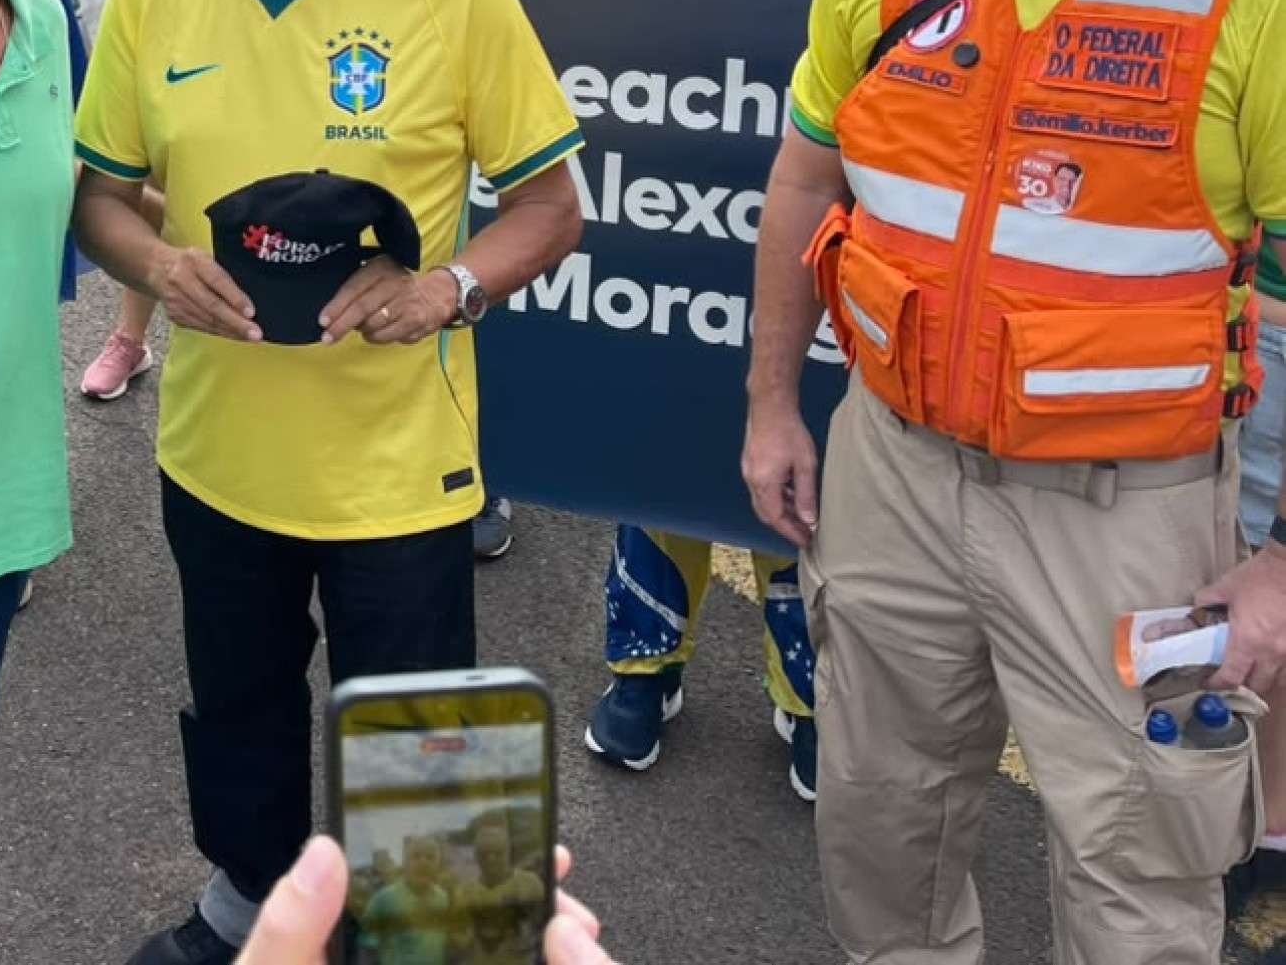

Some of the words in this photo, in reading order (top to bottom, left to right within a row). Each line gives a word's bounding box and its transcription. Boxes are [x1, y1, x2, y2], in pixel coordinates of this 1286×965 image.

[1056, 23, 1071, 49] O
[1079, 25, 1164, 59] FEDERAL
[1047, 52, 1075, 78] DA
[1083, 56, 1161, 89] DIREITA
[560, 58, 791, 137] each
[325, 125, 389, 140] BRASIL
[507, 252, 850, 364] Moras
